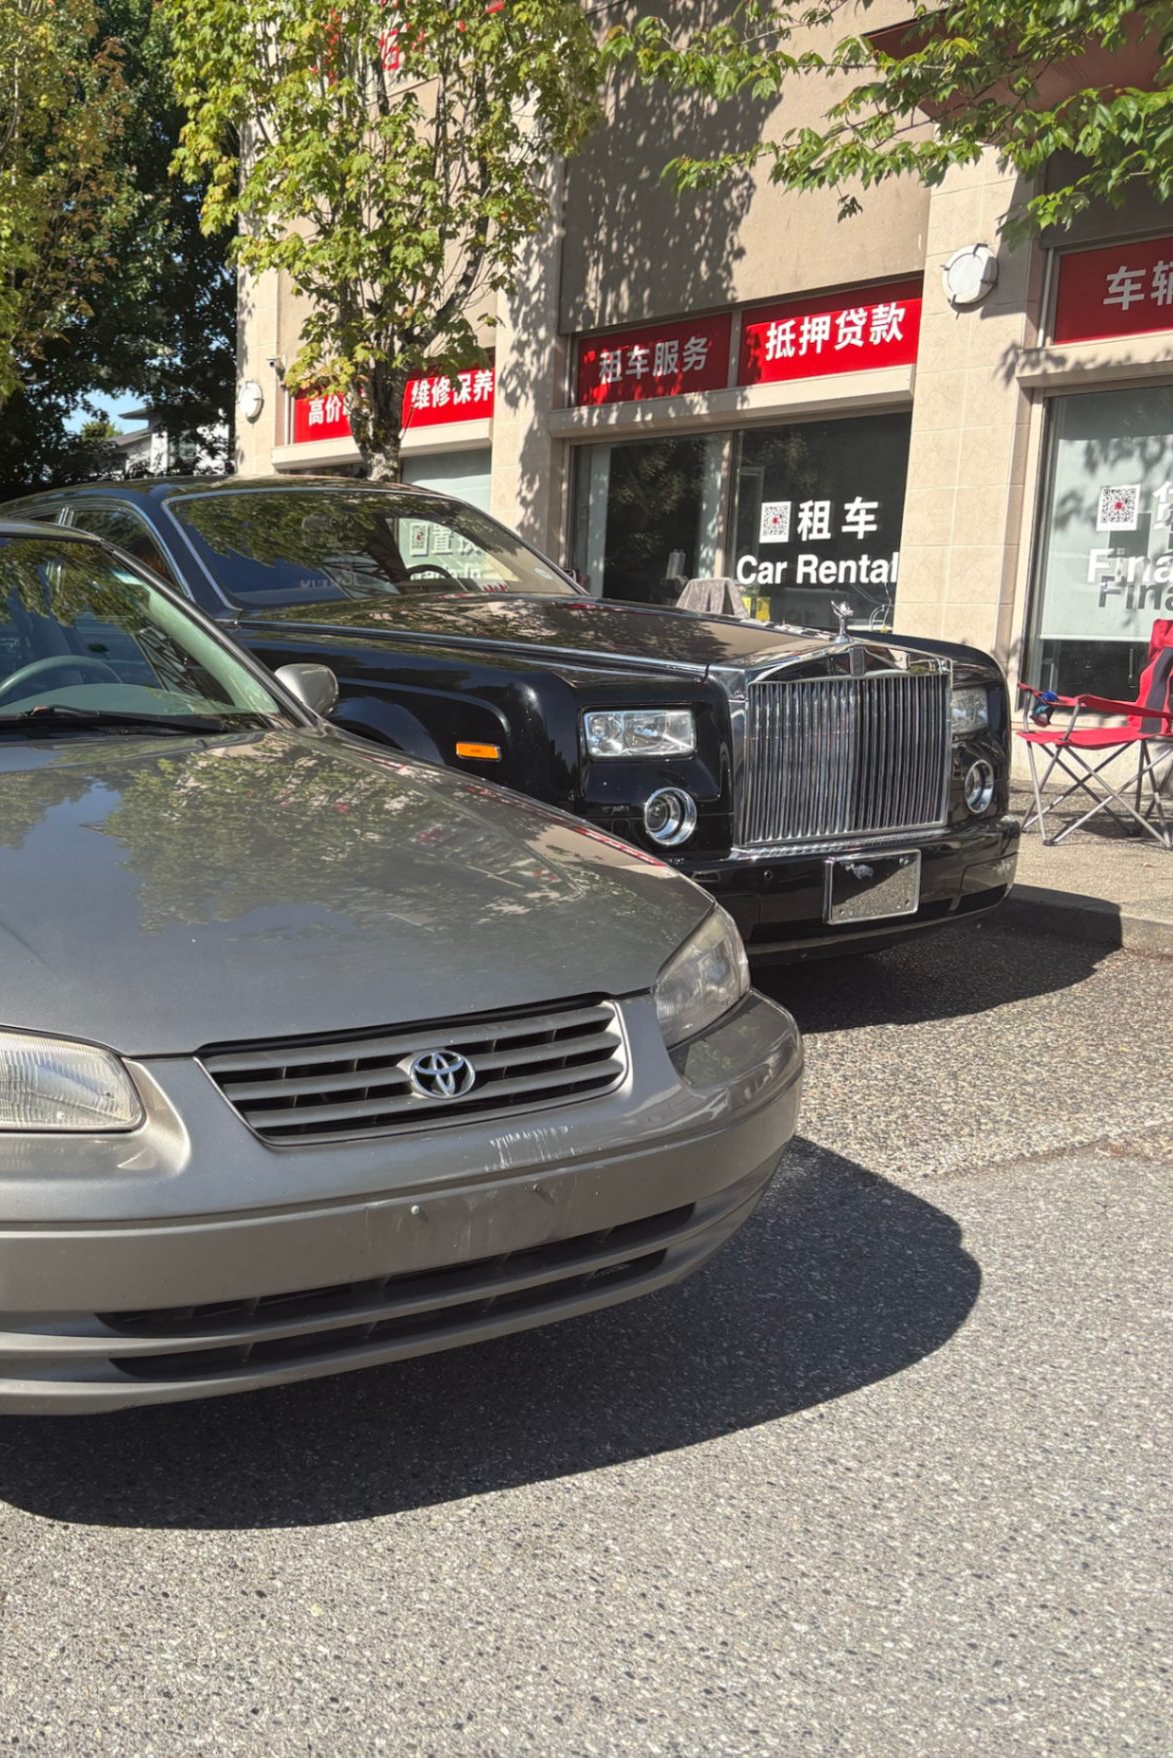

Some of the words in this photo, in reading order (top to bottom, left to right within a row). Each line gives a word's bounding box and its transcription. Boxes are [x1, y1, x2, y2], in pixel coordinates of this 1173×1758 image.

[765, 302, 905, 361] 抵押贷款
[599, 336, 708, 383] 租车服务
[412, 371, 493, 410] 维修保养
[797, 496, 879, 541] 租车
[736, 554, 787, 585] Car
[796, 552, 899, 584] Rental
